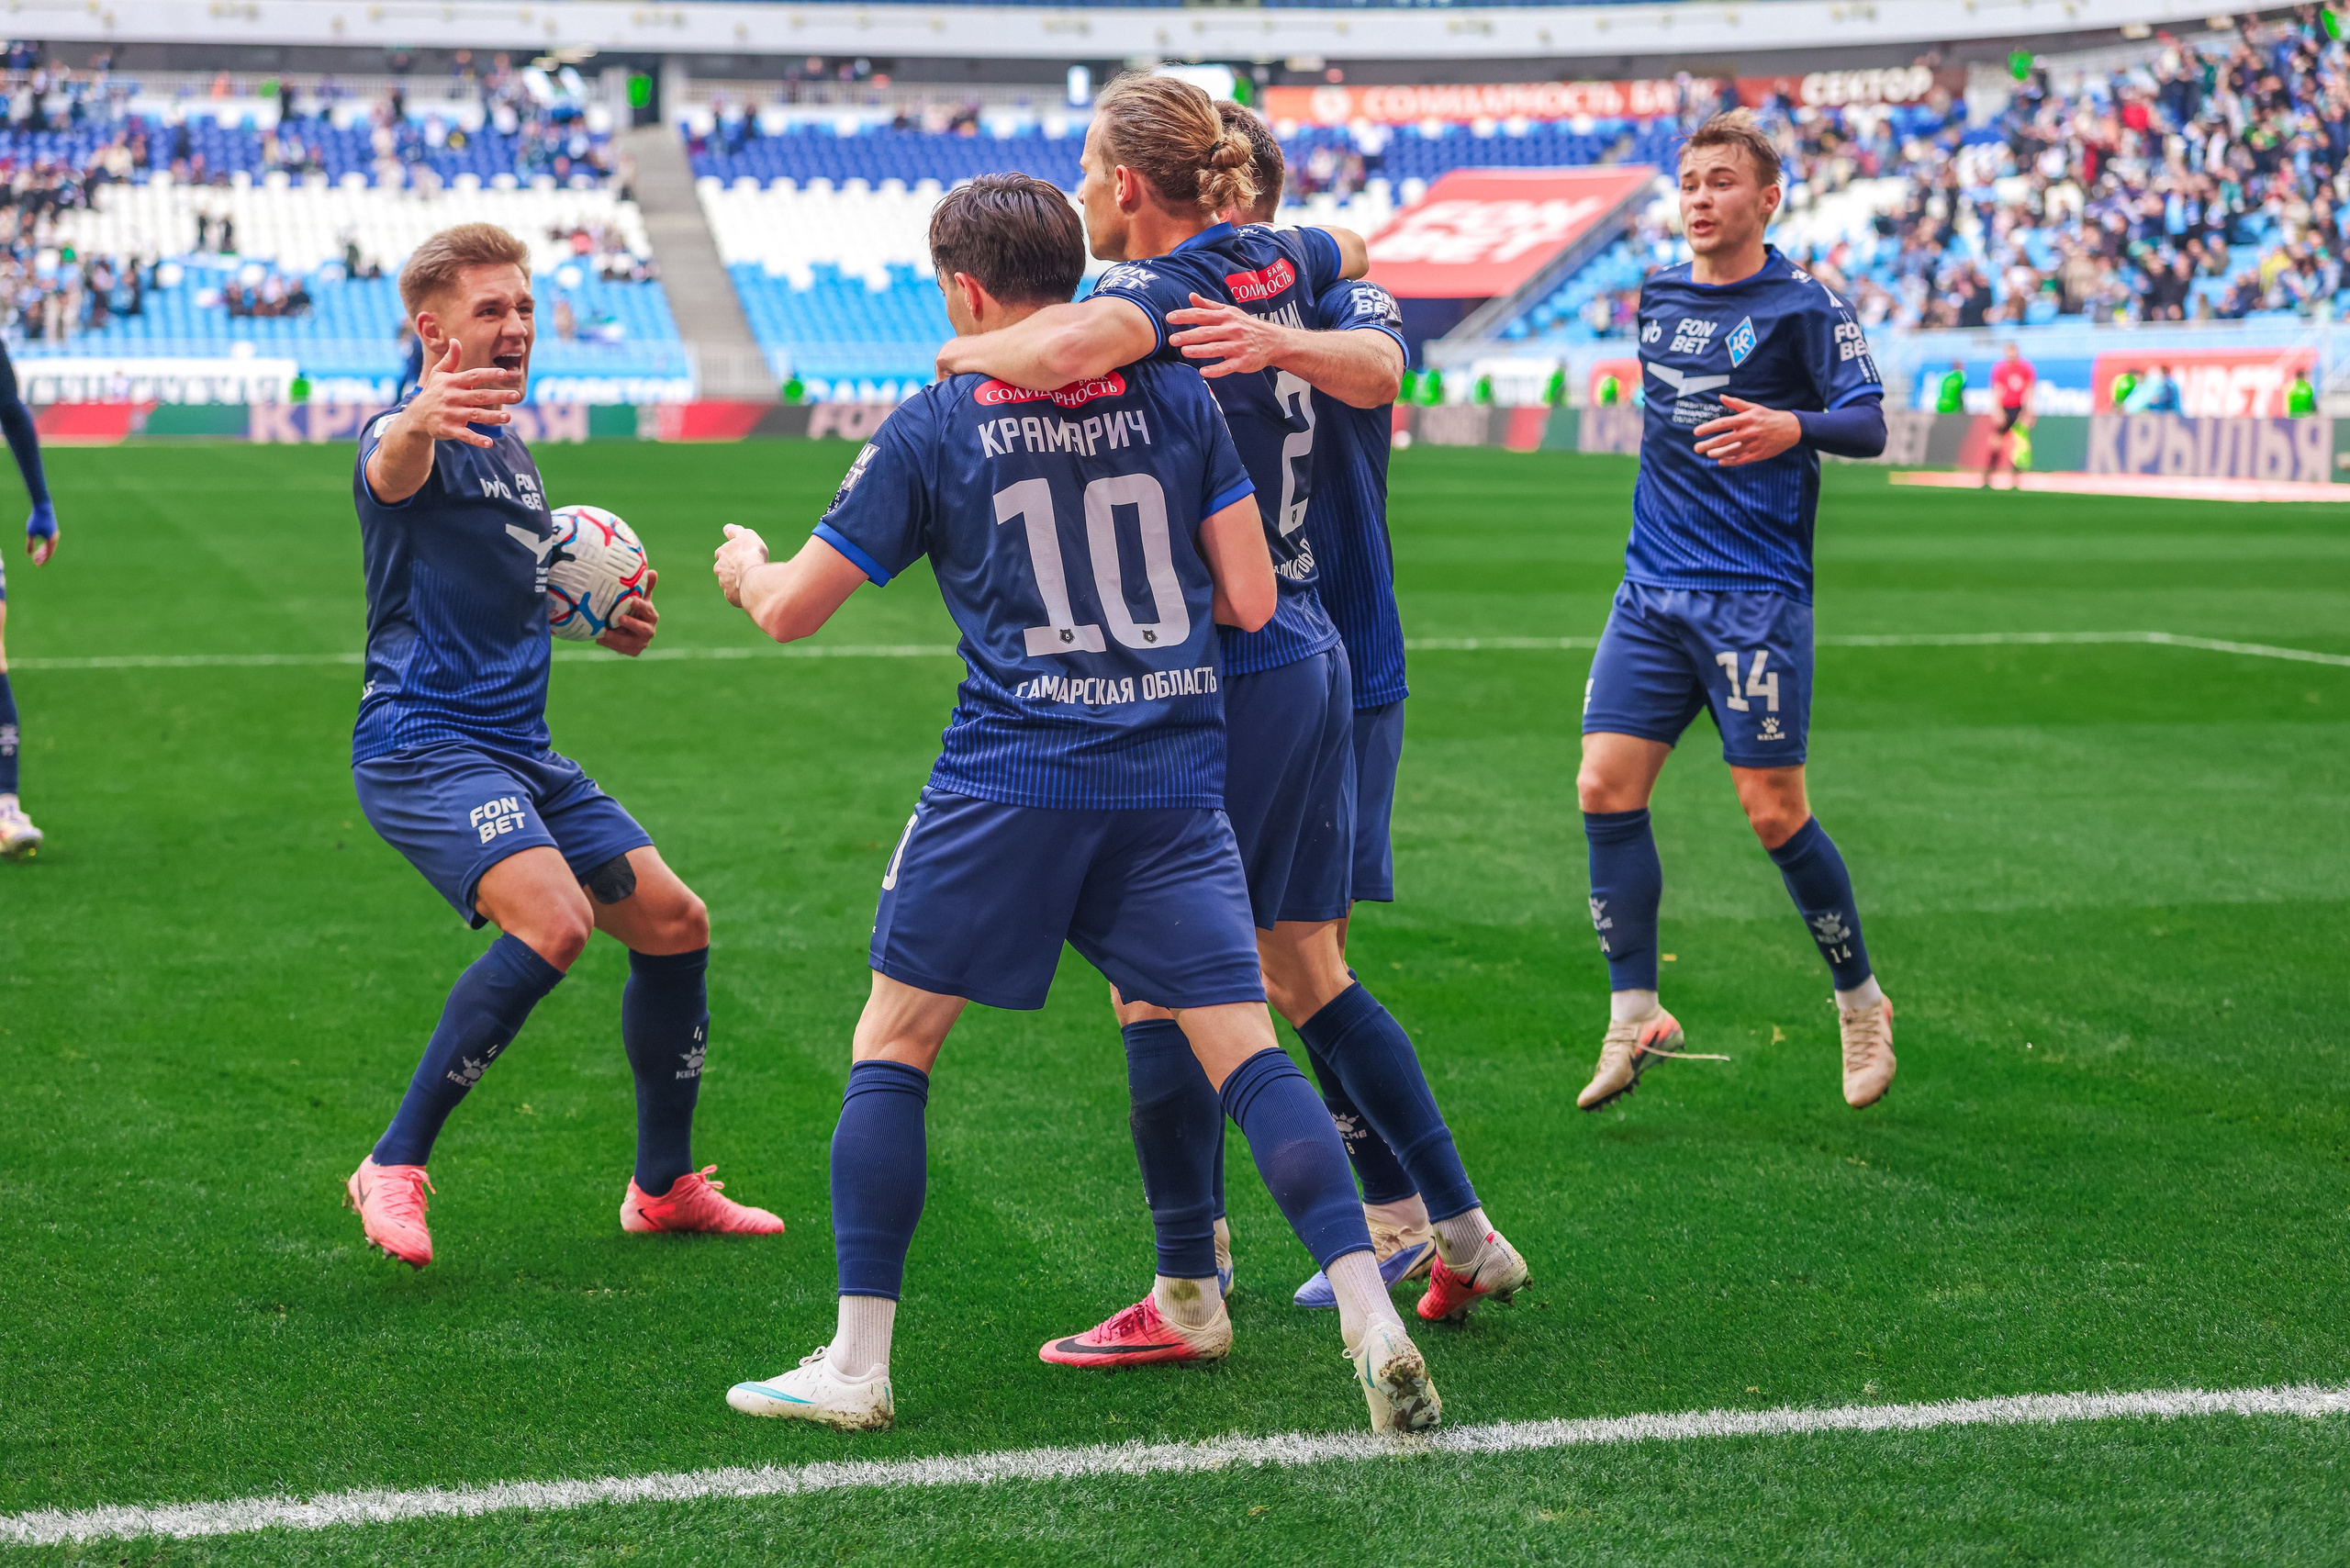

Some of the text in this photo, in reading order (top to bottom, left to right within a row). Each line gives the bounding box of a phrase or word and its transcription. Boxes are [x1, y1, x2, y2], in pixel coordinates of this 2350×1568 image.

[1800, 66, 1934, 106] СЕКТОР
[1230, 270, 1292, 300] СОЛИОСТЬ
[1669, 334, 1710, 355] BET
[1675, 318, 1718, 338] FON
[1834, 322, 1863, 343] FO
[1839, 339, 1869, 362] BE
[978, 409, 1152, 459] КРАМАРИЧ
[2087, 415, 2333, 481] КРЫЛЬЯ
[1274, 369, 1316, 538] 2
[992, 473, 1191, 657] 10
[1015, 666, 1218, 706] САМАРСКАЯ ОБЛАСТЬ
[1716, 650, 1779, 711] 14
[469, 796, 520, 829] FON
[478, 812, 526, 845] BET
[1830, 944, 1852, 964] 14
[1339, 1129, 1368, 1139] LME
